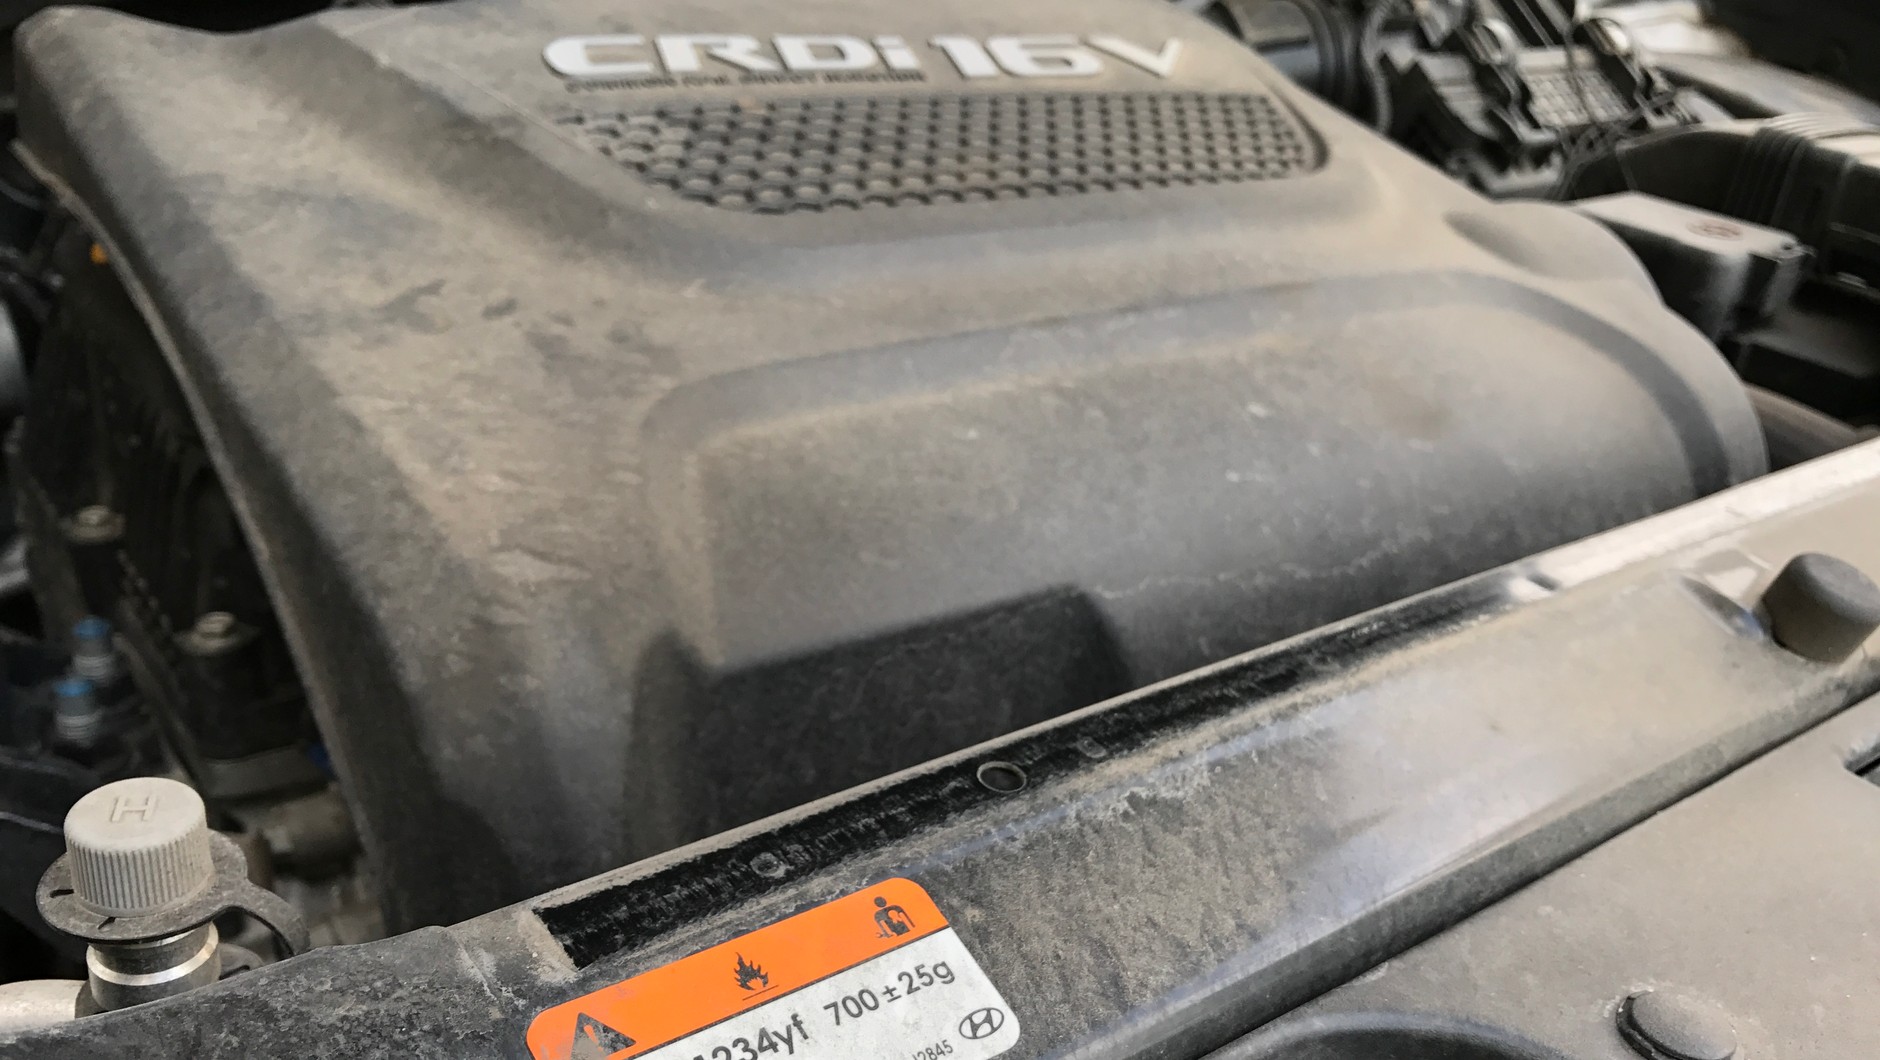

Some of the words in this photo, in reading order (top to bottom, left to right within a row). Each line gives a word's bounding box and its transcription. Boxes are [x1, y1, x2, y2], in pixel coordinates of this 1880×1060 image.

[542, 34, 922, 76] CRDi
[929, 34, 1181, 79] 16V
[110, 795, 156, 823] H
[693, 1013, 809, 1060] 234yf
